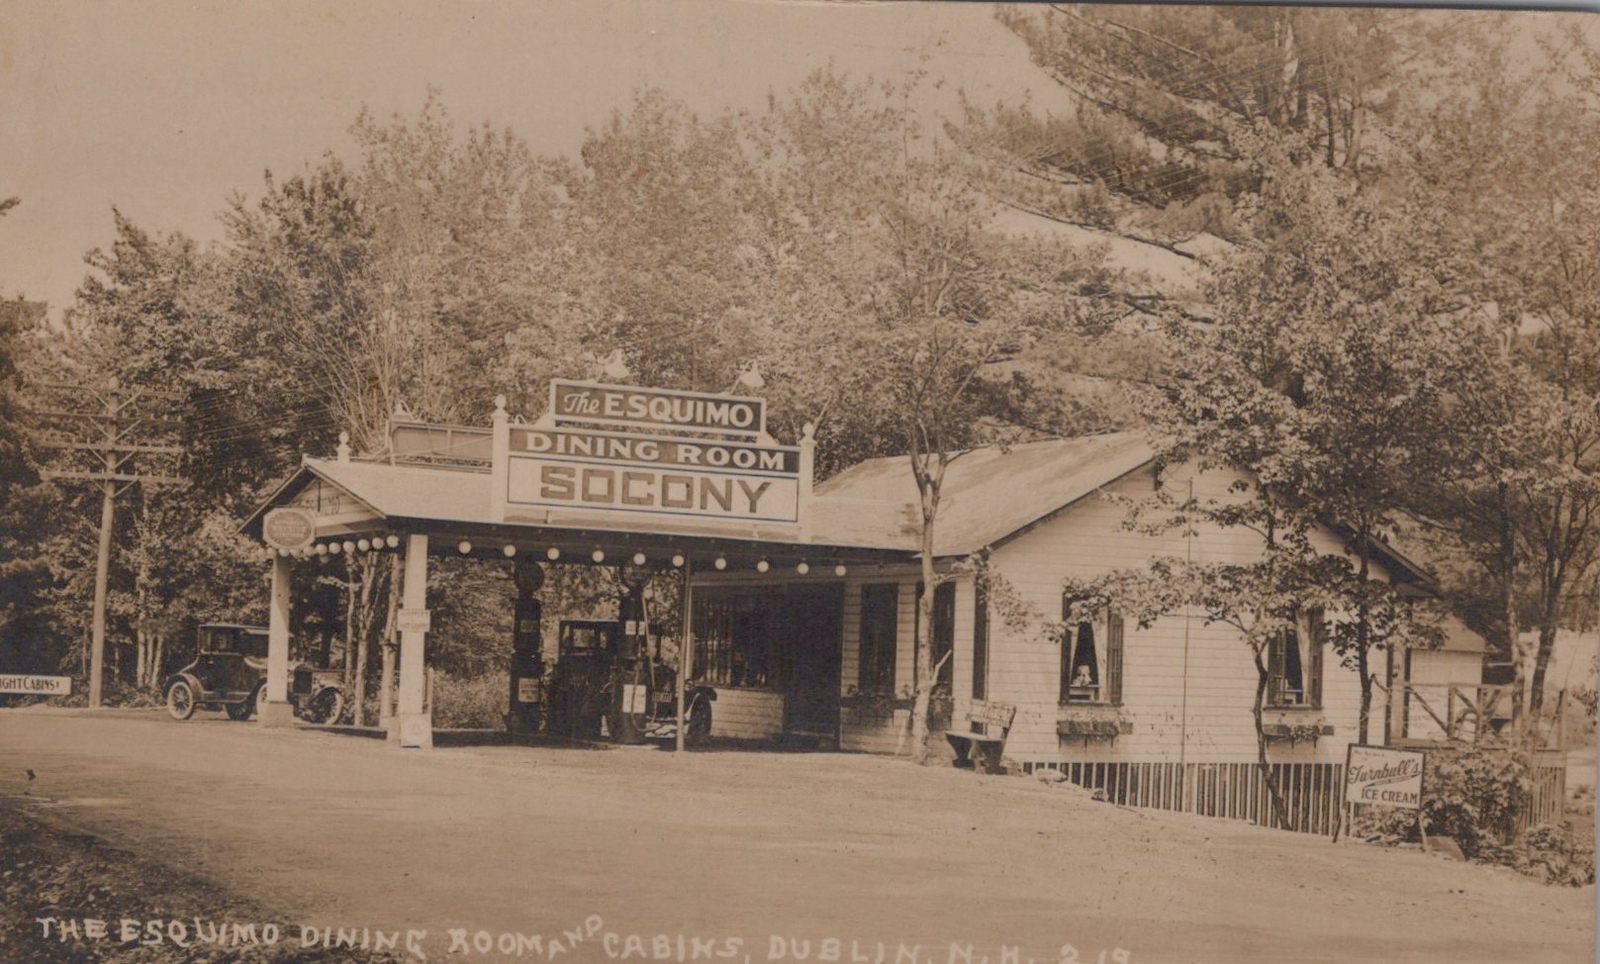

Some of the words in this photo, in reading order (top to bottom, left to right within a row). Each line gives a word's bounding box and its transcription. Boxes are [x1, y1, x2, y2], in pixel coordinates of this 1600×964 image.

[563, 391, 600, 415] The
[604, 393, 754, 428] ESQUIMO
[526, 432, 660, 461] DINING
[677, 444, 785, 470] ROOM
[540, 465, 772, 513] SOCONY
[1348, 759, 1419, 785] Turnbull's
[1361, 788, 1378, 800] ICE
[1381, 790, 1418, 804] CREAM
